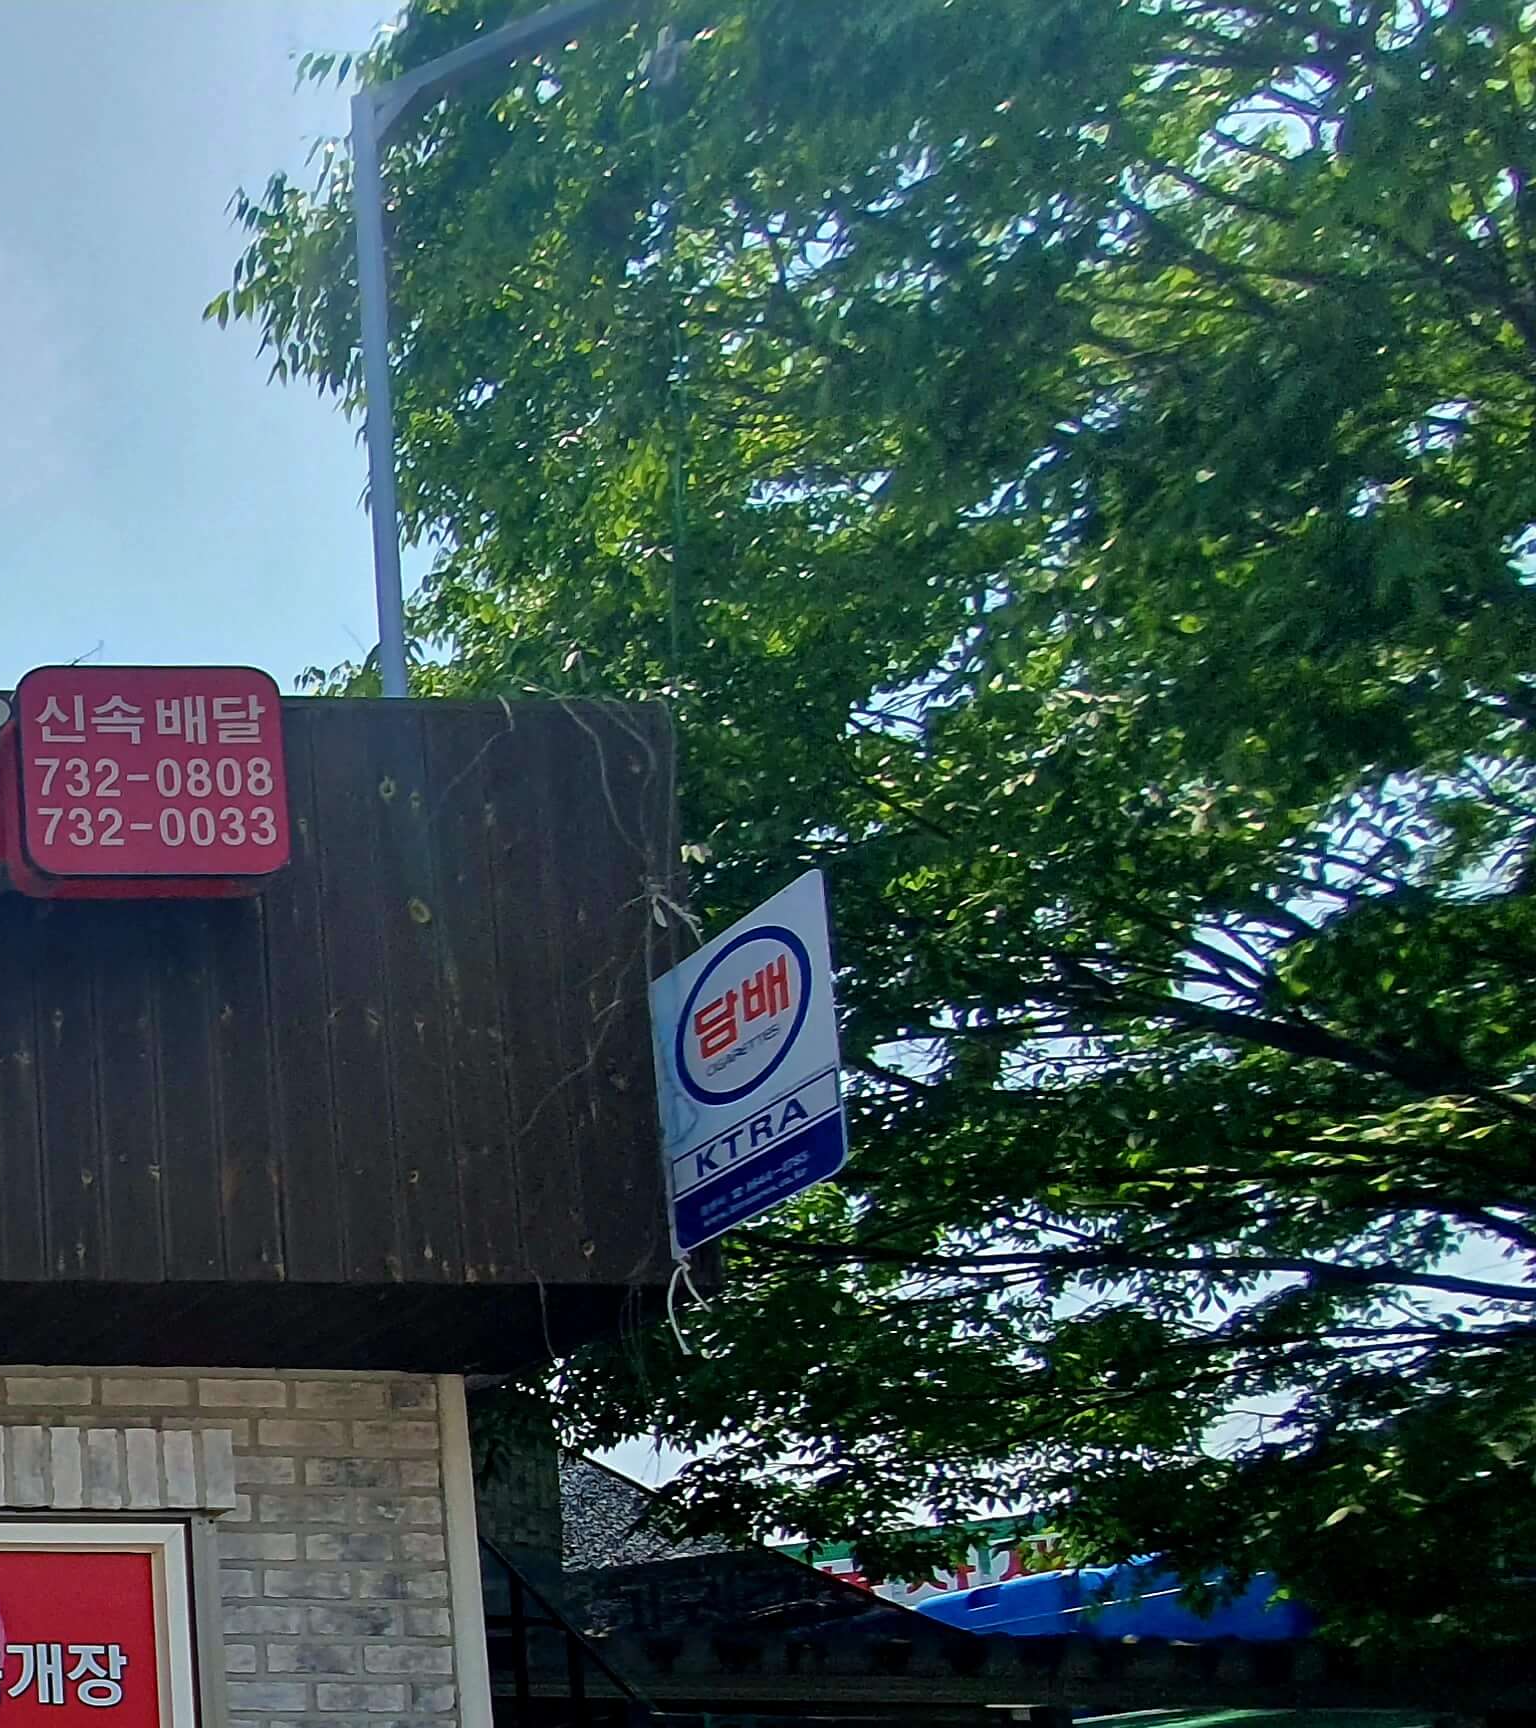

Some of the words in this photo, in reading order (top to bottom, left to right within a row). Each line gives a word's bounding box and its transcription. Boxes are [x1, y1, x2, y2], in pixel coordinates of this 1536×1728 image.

[35, 695, 145, 744] 신속
[155, 695, 266, 744] 배달
[34, 757, 274, 798] 732-0808
[37, 806, 278, 847] 732-0033
[694, 953, 790, 1060] 담배
[695, 1097, 809, 1178] KTRA
